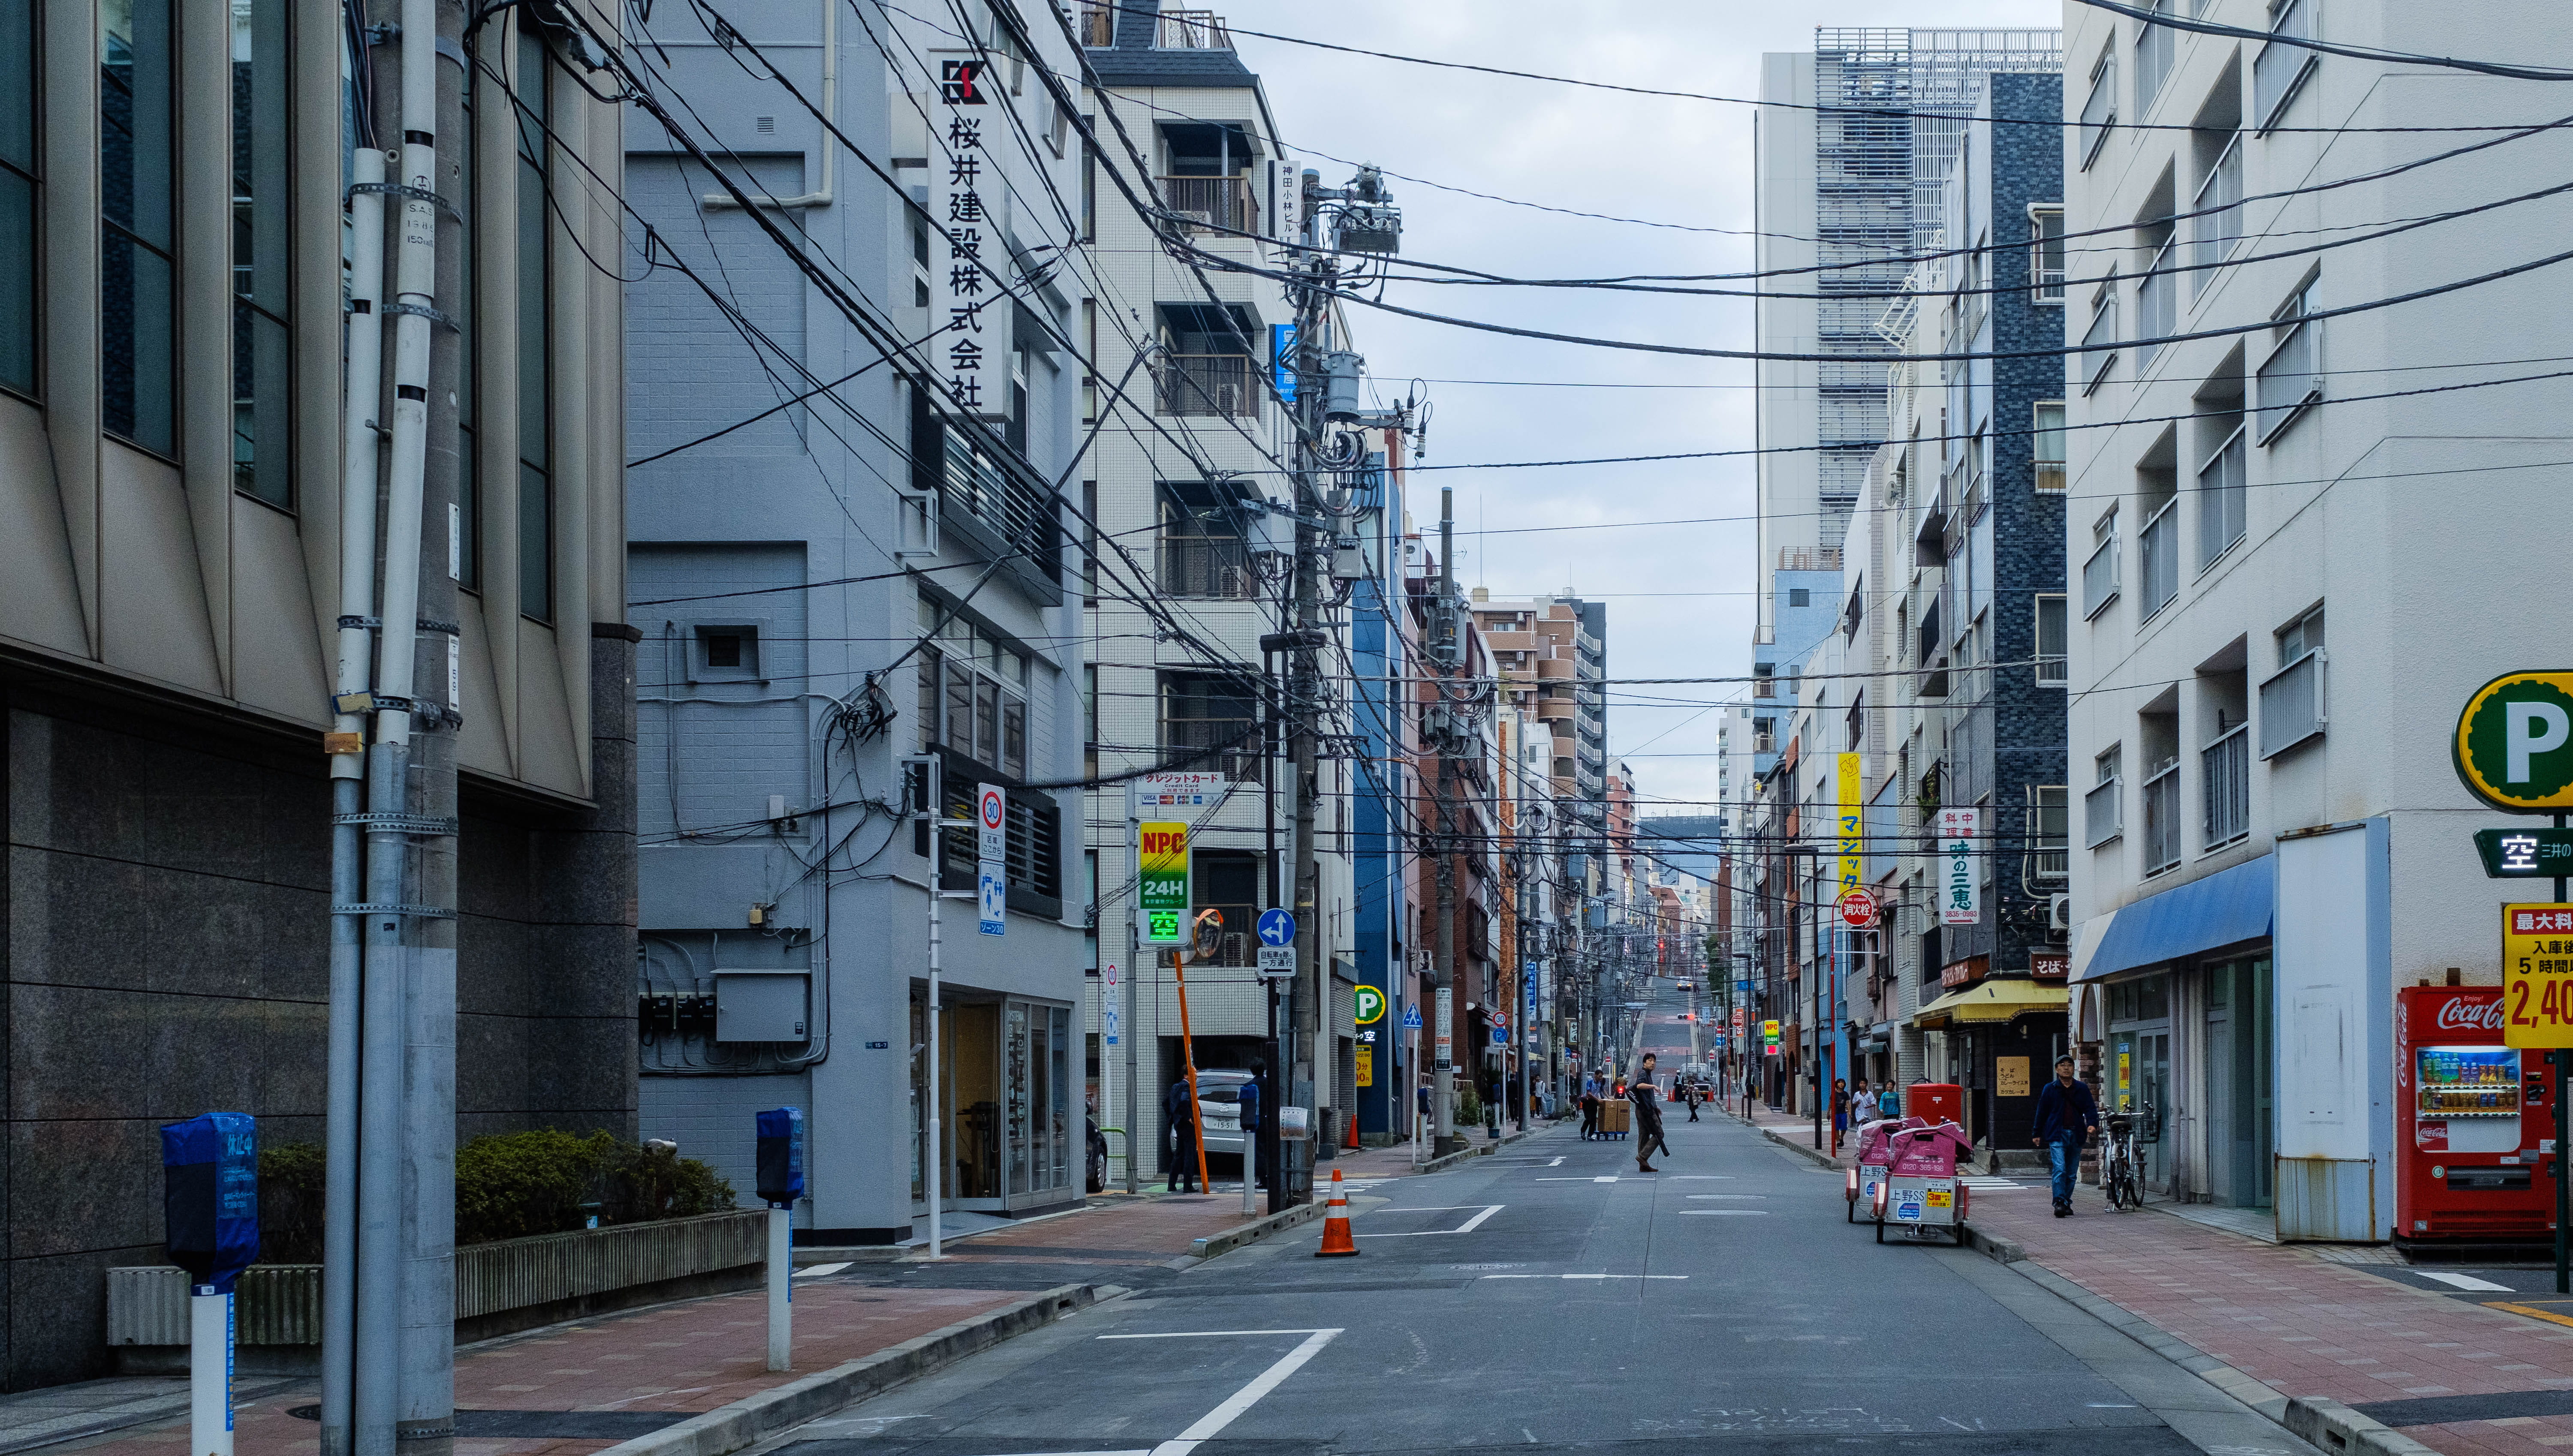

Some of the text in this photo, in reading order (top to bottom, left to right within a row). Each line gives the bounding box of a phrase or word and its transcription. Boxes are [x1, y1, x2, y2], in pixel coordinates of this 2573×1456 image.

[1283, 166, 1293, 232] 神田小林ビル
[949, 117, 983, 406] 桜井建設株式会社
[2506, 702, 2570, 783] P
[1146, 774, 1217, 783] クレジットカード
[987, 802, 998, 819] 30
[1962, 813, 1973, 837] 中華
[983, 845, 1001, 854] ここから
[1143, 833, 1184, 854] NPC
[2502, 835, 2537, 869] 空
[1144, 881, 1183, 895] 24H
[1844, 903, 1870, 916] 消火栓
[981, 923, 1003, 934] ゾーン30
[1150, 912, 1179, 941] 空
[2519, 957, 2531, 974] 5
[1359, 993, 1378, 1017] P
[1364, 1031, 1375, 1041] 空
[1496, 1032, 1502, 1041] P
[2397, 1000, 2407, 1087] Coca-Cola
[2419, 1128, 2448, 1137] Coca-Cola
[1902, 1163, 1944, 1172] 0120-365-198
[1890, 1189, 1924, 1201] 上野SS
